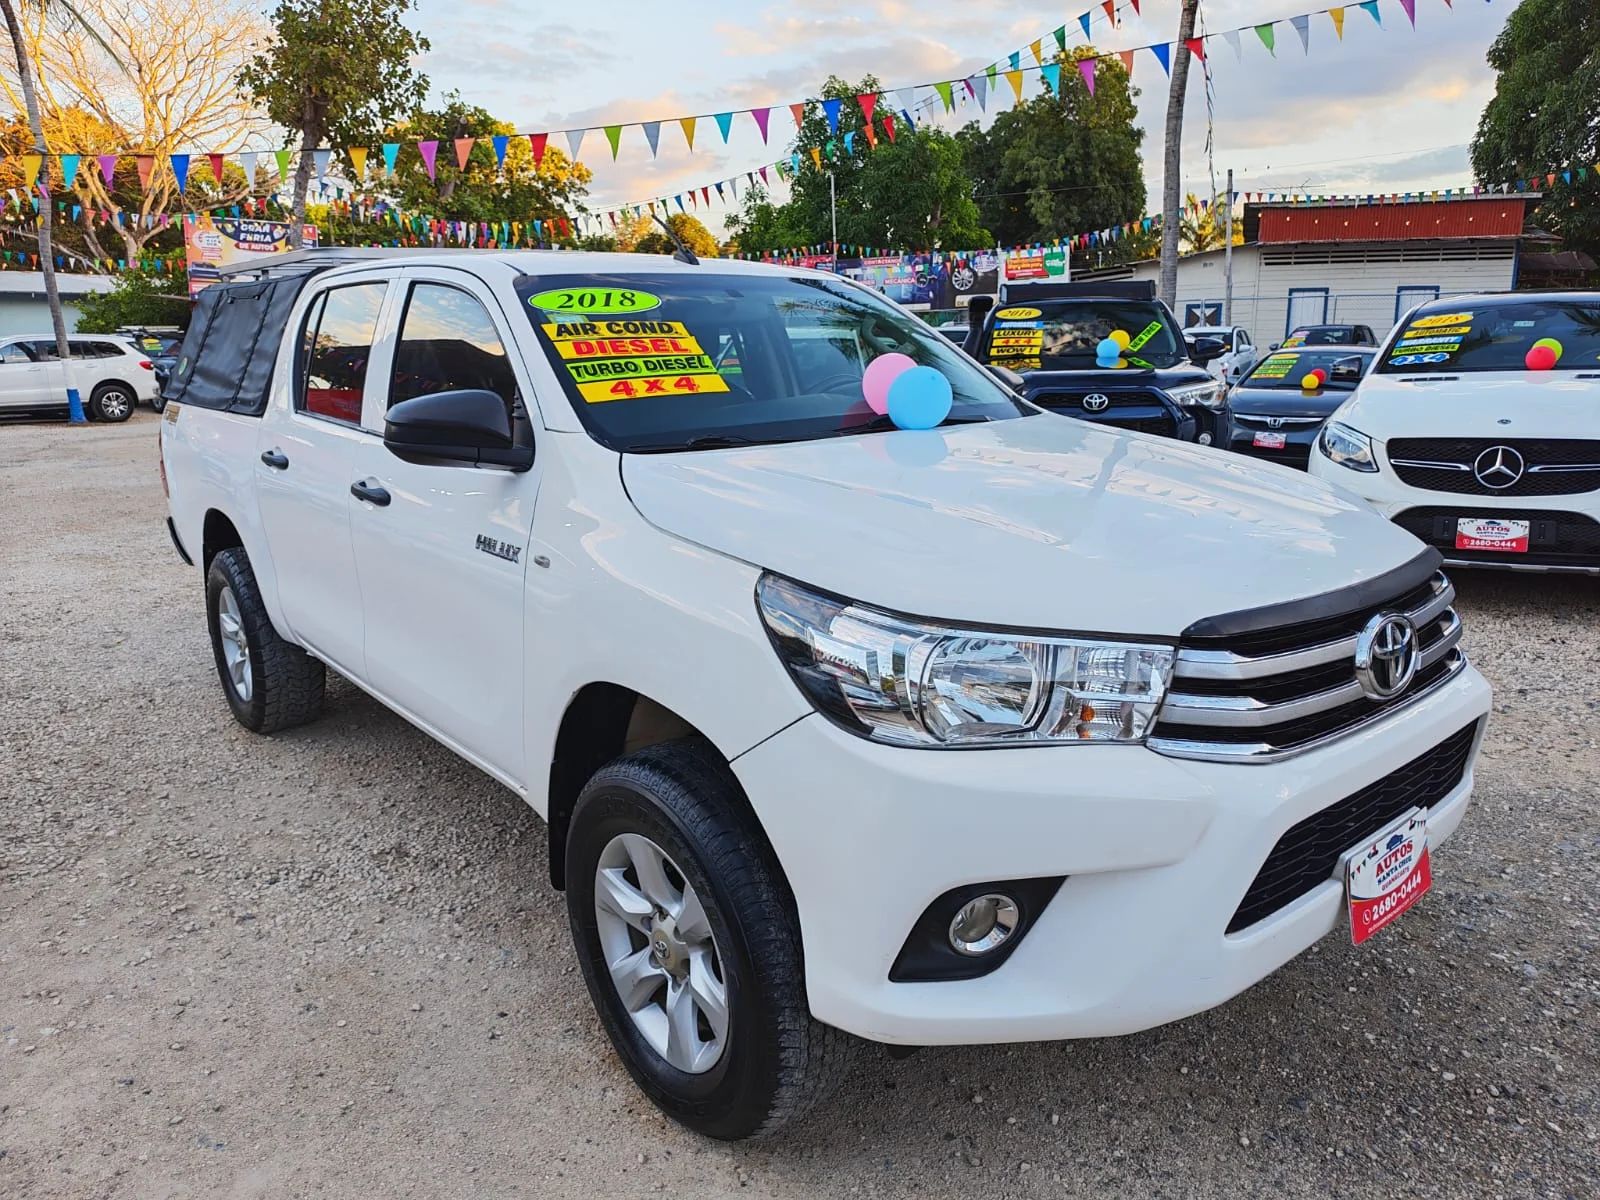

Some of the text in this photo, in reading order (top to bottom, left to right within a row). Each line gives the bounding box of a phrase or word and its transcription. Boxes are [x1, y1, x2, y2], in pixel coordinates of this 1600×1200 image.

[240, 223, 270, 233] GRAN
[240, 232, 273, 243] FERIA
[238, 242, 275, 252] DE AUTOS
[556, 291, 637, 310] 2018
[1006, 309, 1033, 318] 2016
[1420, 315, 1462, 326] 2018
[555, 321, 680, 337] AIR COND.
[1413, 327, 1463, 337] AUTOMATIC
[571, 338, 693, 357] DIESEL
[1423, 344, 1458, 352] DIESEL
[570, 356, 710, 379] TURBO DIESEL
[1475, 525, 1511, 533] AUTOS
[475, 533, 521, 564] HILUX
[1470, 539, 1517, 548] 2680-0444
[1375, 840, 1413, 878] AUTOS
[1377, 855, 1413, 885] SANTA CRUZ
[1371, 869, 1422, 921] 2680-0444
